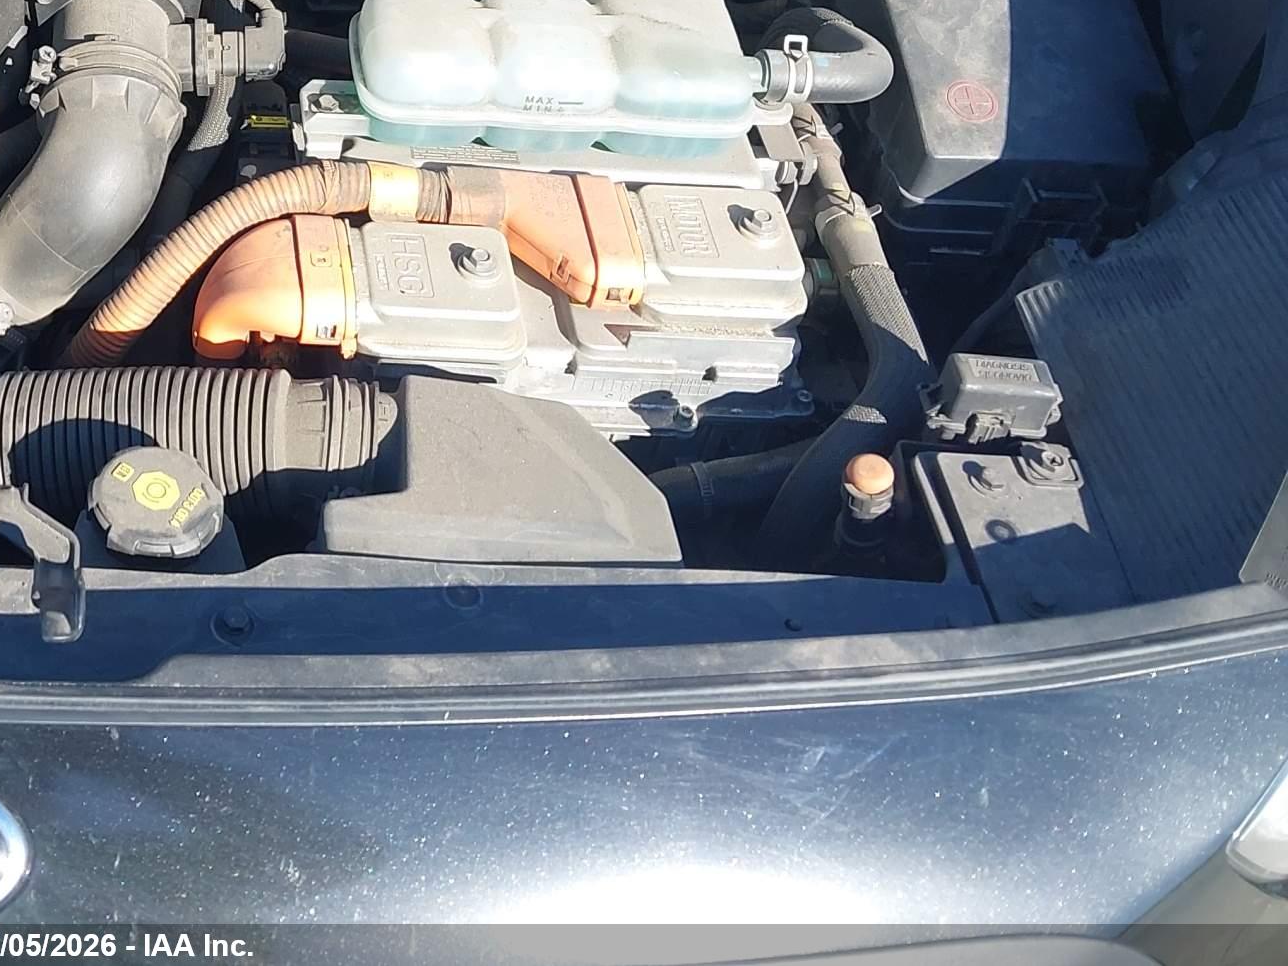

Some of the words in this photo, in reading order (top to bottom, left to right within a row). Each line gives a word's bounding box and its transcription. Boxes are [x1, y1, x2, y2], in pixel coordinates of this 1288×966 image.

[523, 104, 553, 113] MIN
[525, 94, 555, 105] MAX
[668, 199, 712, 255] MOTOR
[389, 237, 424, 294] HSG
